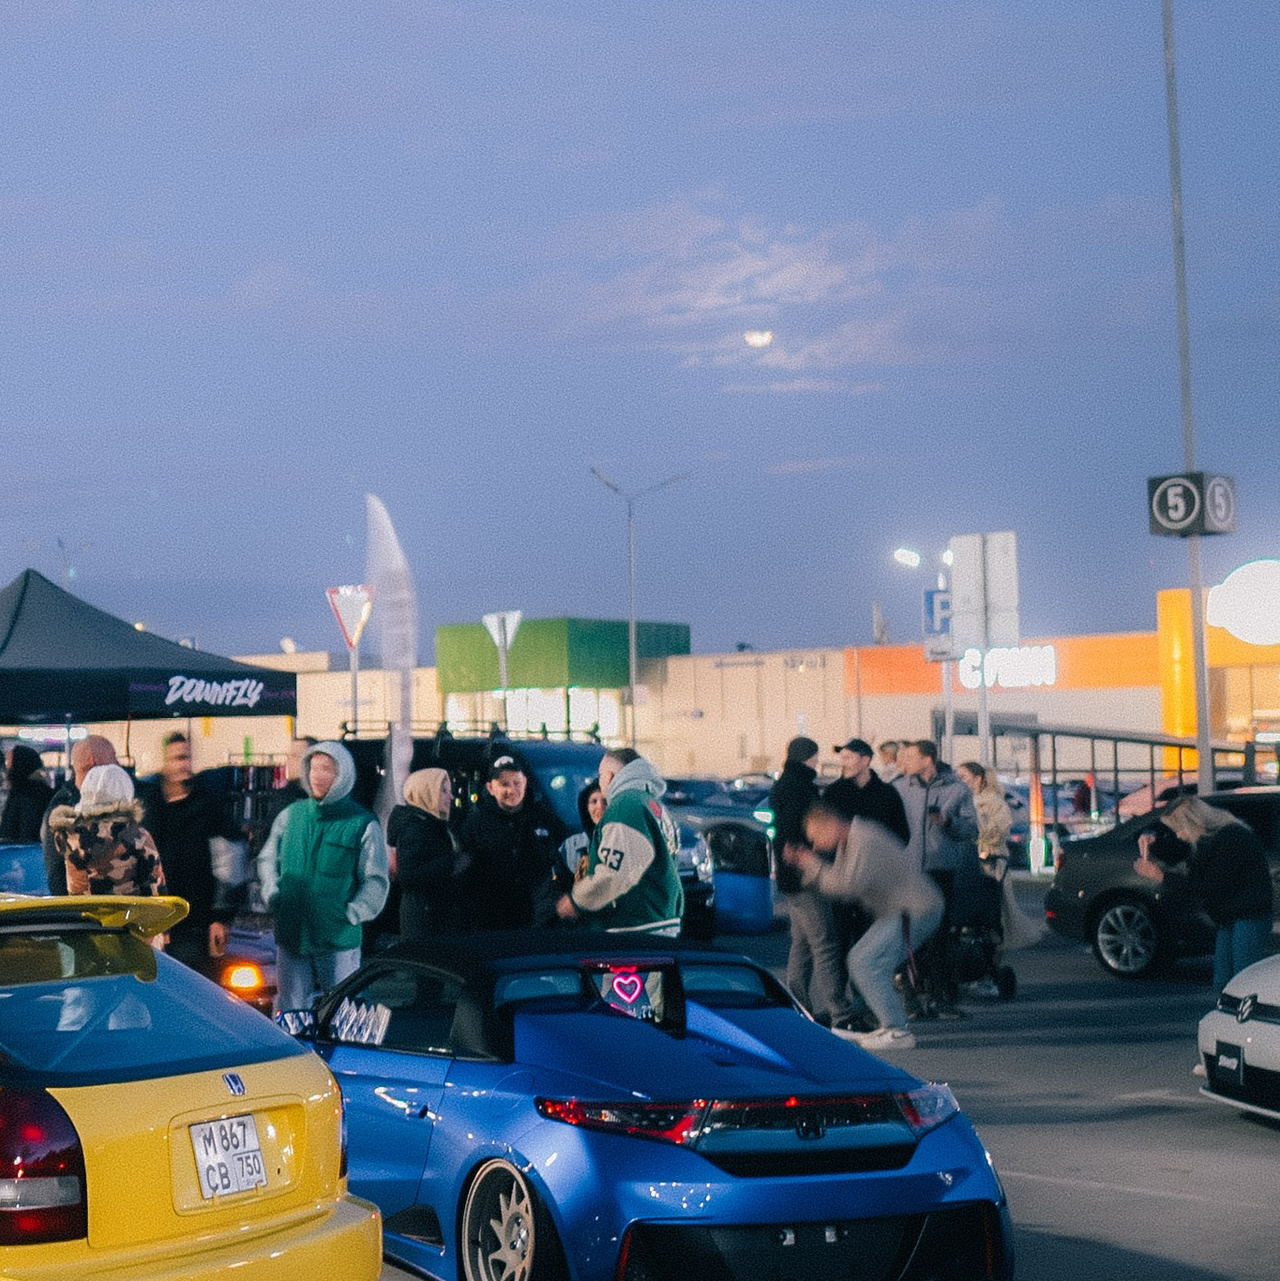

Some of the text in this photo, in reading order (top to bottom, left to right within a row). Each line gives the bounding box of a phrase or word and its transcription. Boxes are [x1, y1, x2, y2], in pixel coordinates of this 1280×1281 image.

[1167, 486, 1186, 520] 5
[165, 675, 264, 708] DOWNFLY
[220, 1121, 248, 1152] 867
[237, 1154, 261, 1178] 750
